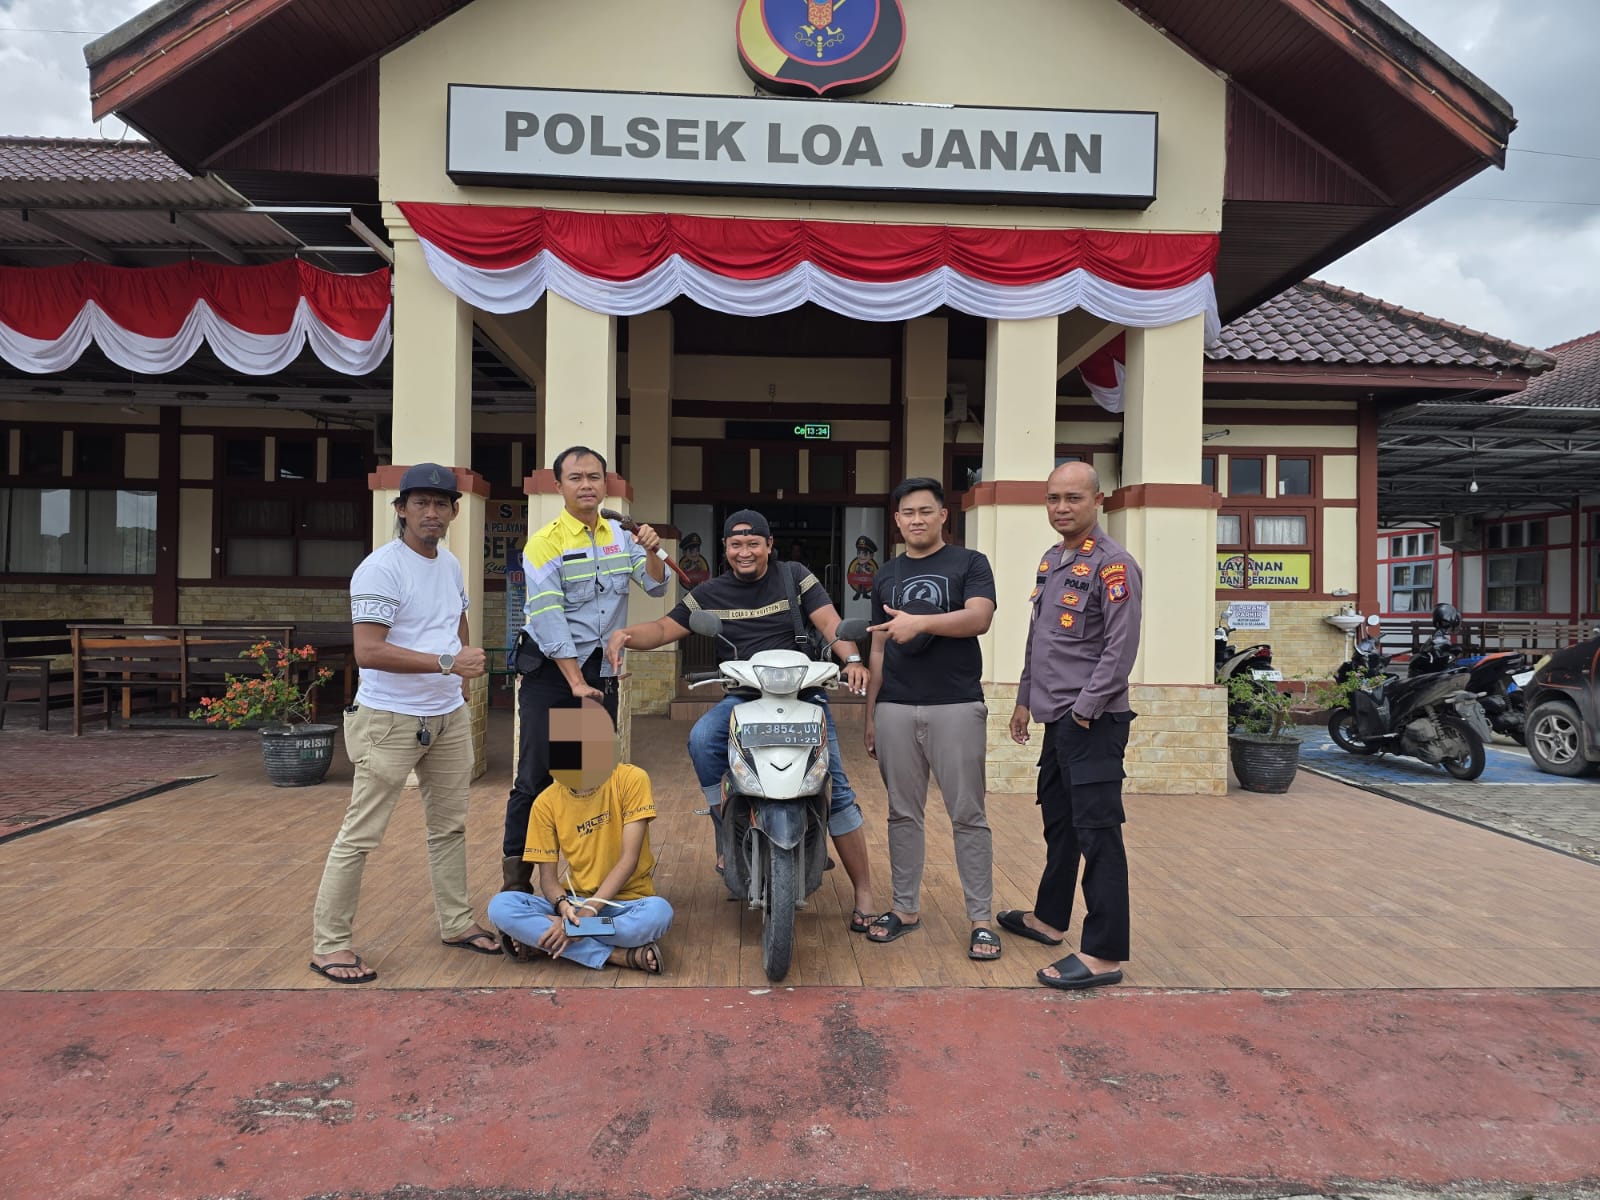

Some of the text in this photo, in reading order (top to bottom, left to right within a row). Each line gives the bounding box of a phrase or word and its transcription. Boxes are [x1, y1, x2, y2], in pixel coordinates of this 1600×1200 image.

[504, 110, 1102, 174] POLSEK LOA JANAN
[1063, 578, 1090, 592] POLRI
[1220, 576, 1240, 585] DAN
[743, 724, 818, 735] KT 3854 UV
